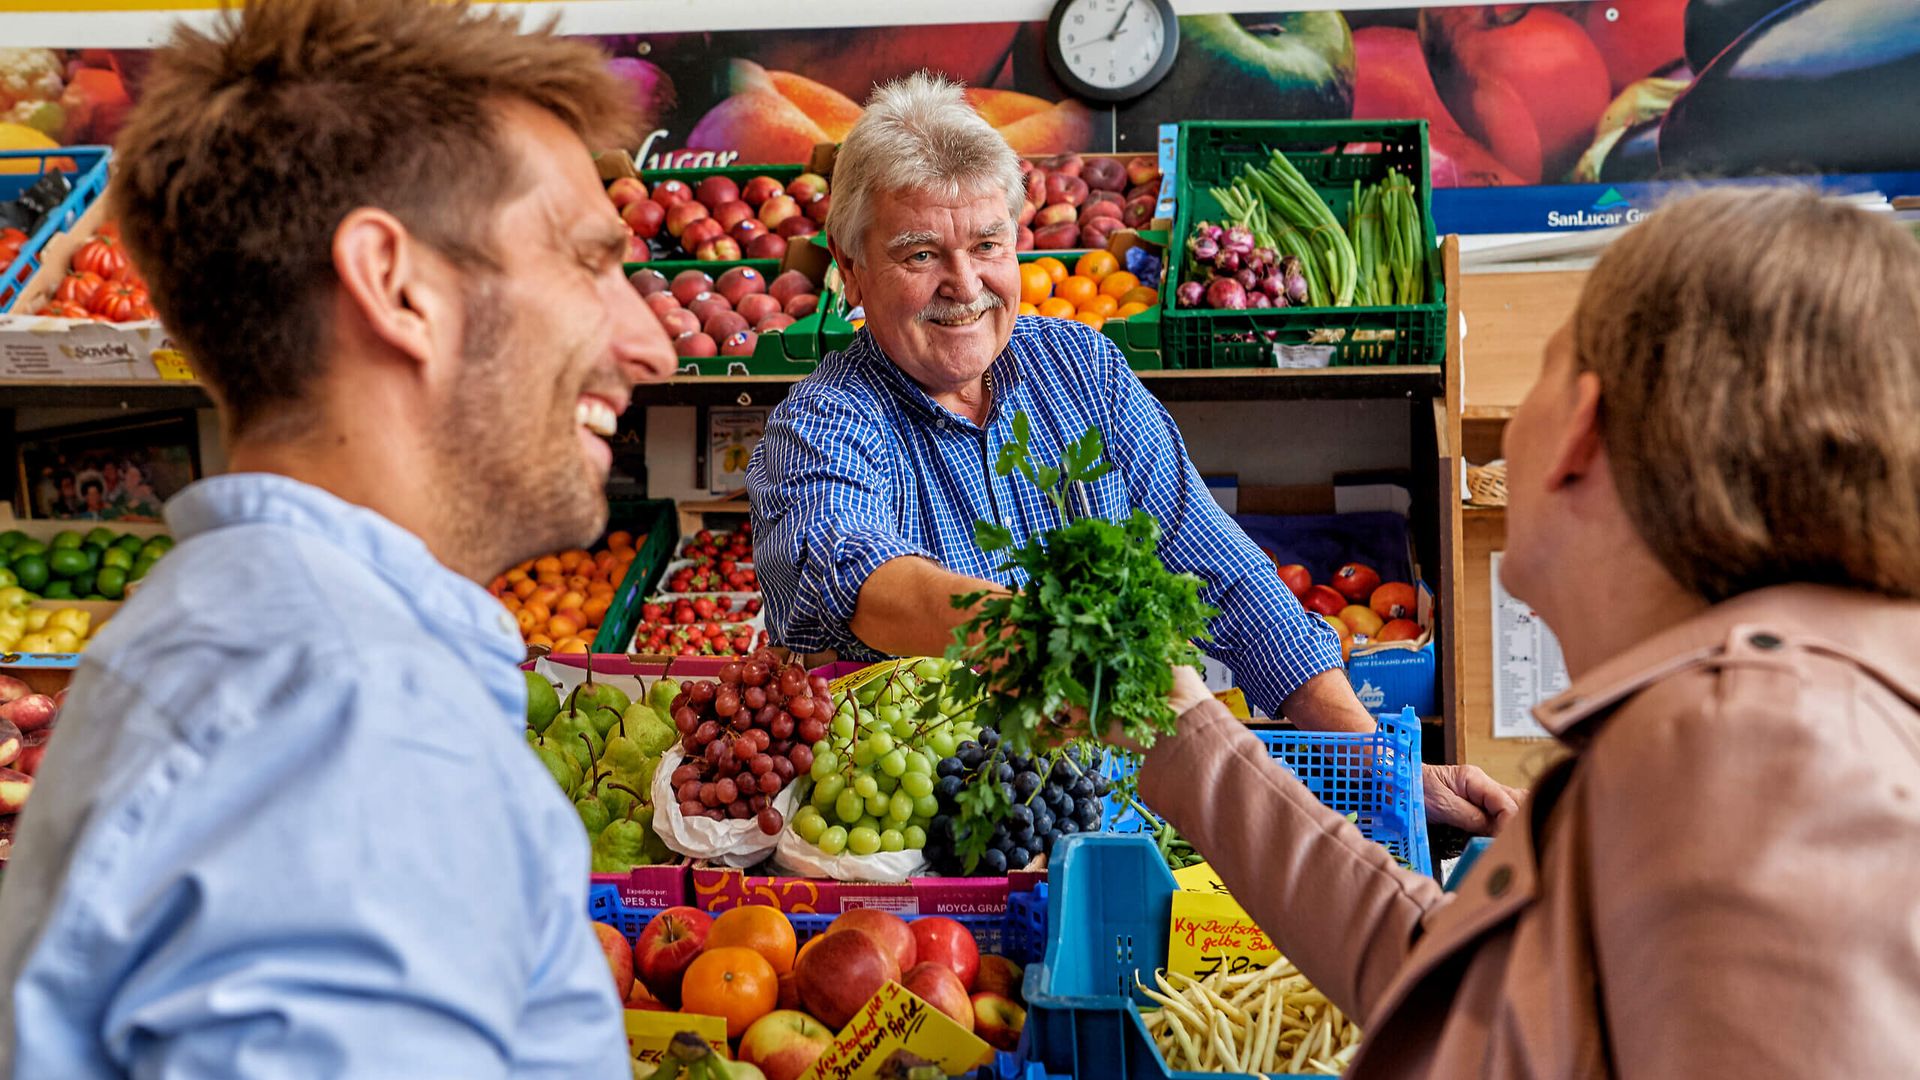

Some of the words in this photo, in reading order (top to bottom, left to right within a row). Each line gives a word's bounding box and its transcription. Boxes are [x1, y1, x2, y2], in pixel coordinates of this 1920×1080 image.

[1073, 15, 1085, 25] 10
[1067, 34, 1075, 44] 9
[1074, 54, 1081, 64] 8
[1089, 67, 1096, 77] 7
[1108, 72, 1116, 82] 6
[1547, 210, 1622, 227] SanLucar
[650, 897, 668, 906] S.L.
[937, 904, 976, 913] MOYCA
[1175, 917, 1200, 947] Kg
[1201, 935, 1241, 953] gelbe
